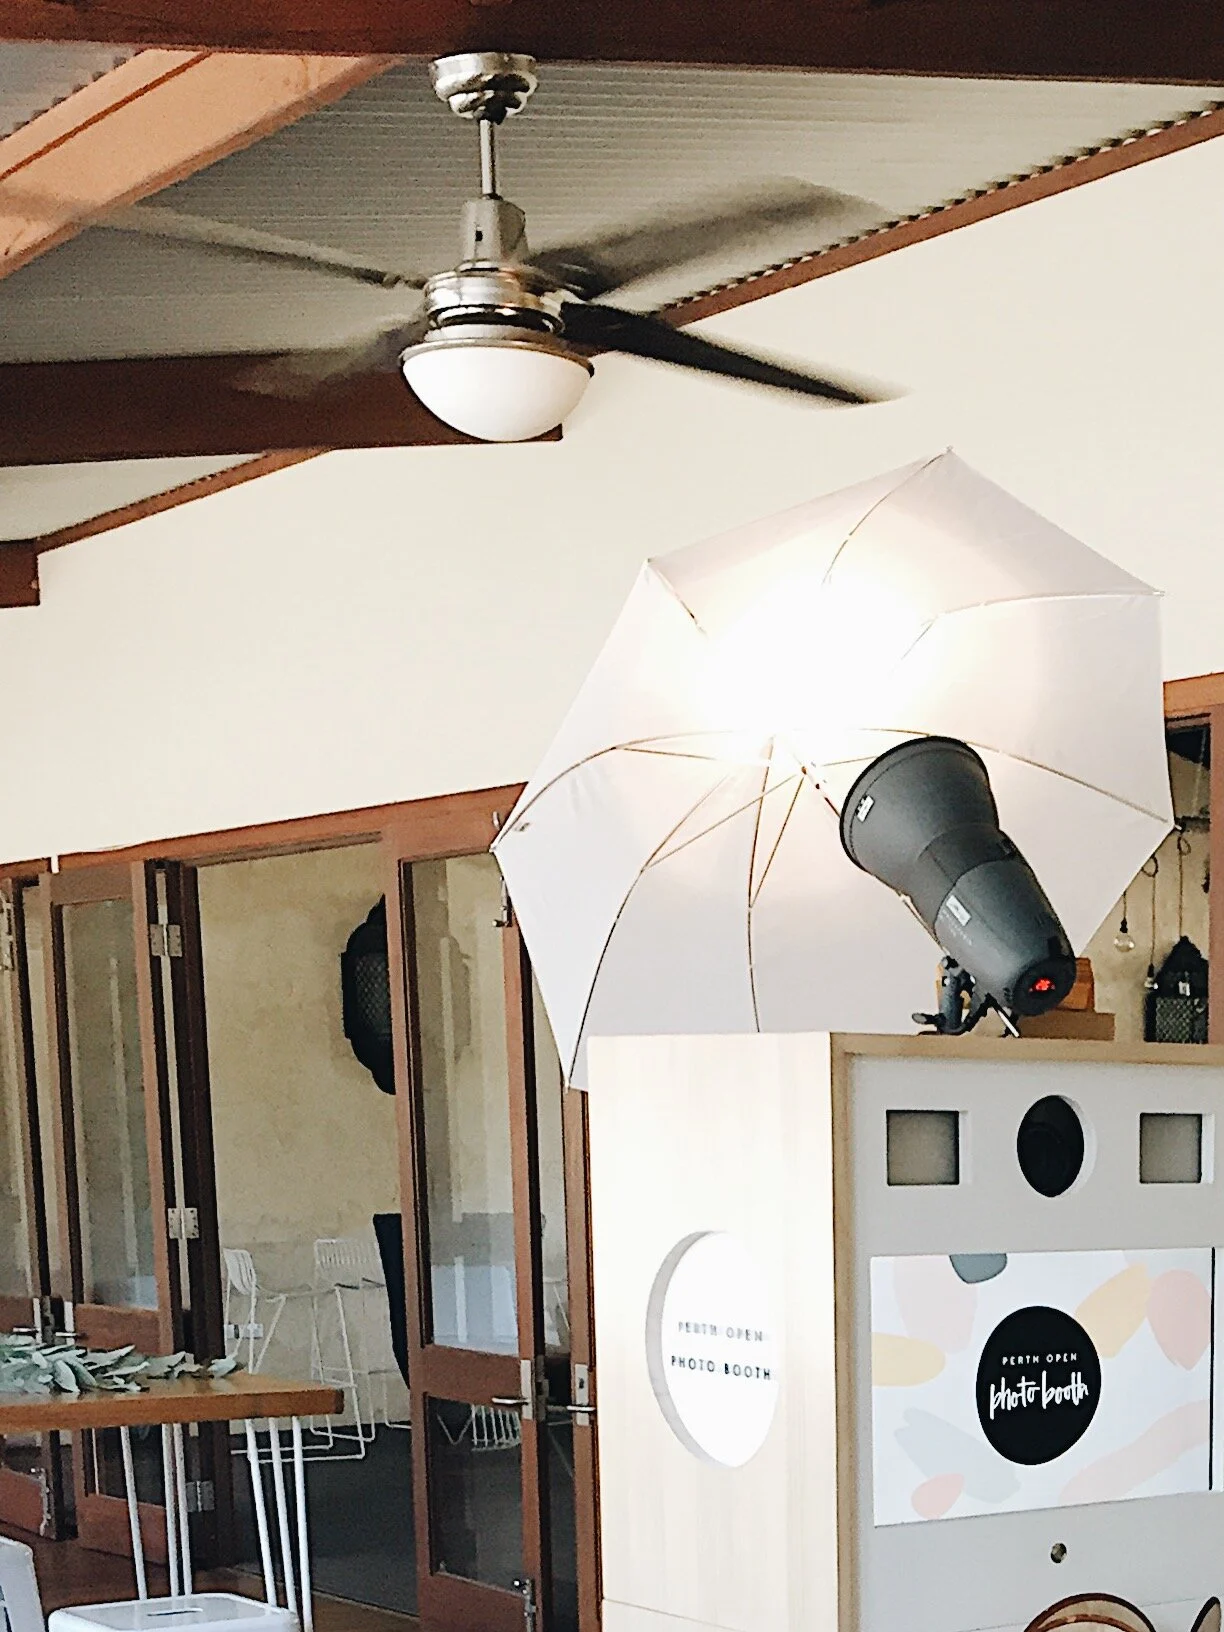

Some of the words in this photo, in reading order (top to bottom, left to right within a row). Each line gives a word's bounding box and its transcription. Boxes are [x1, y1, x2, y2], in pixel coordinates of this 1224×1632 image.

[678, 1321, 717, 1336] PERTH
[726, 1327, 763, 1341] OPEN
[671, 1355, 716, 1372] PHOTO
[724, 1363, 771, 1380] BOOTH
[1002, 1355, 1040, 1366] PERTH
[1046, 1352, 1078, 1363] OPEN
[989, 1376, 1040, 1420] photo
[1041, 1370, 1089, 1409] booth
